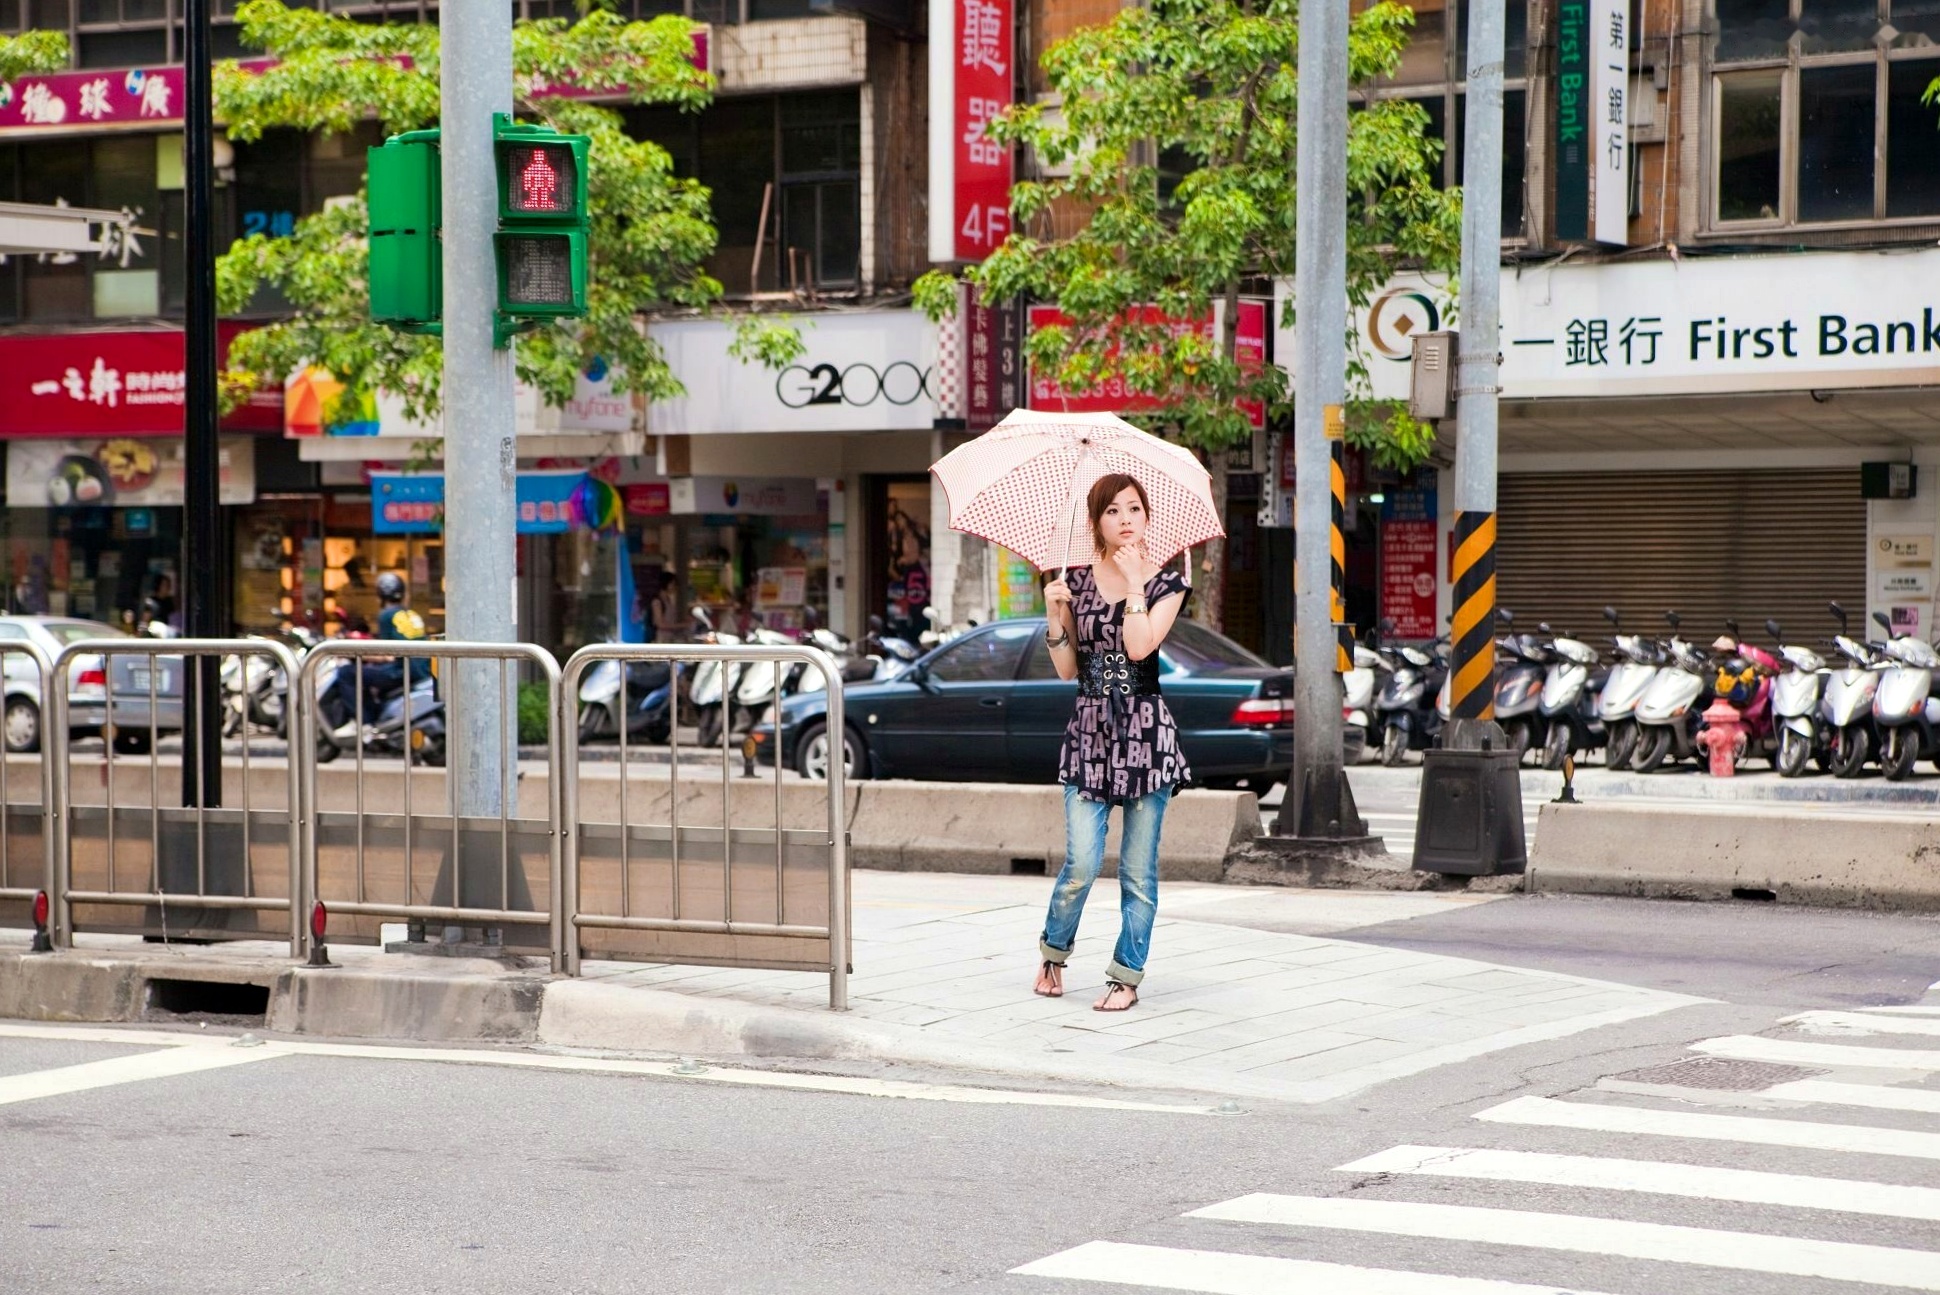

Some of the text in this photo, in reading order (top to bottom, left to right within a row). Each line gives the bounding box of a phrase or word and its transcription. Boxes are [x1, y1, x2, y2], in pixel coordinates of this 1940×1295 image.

[1561, 3, 1583, 142] First Bank
[1608, 11, 1624, 171] 第一銀行
[961, 203, 1006, 247] 4F
[1499, 307, 1940, 366] 一銀行 First Bank
[776, 360, 933, 408] G200
